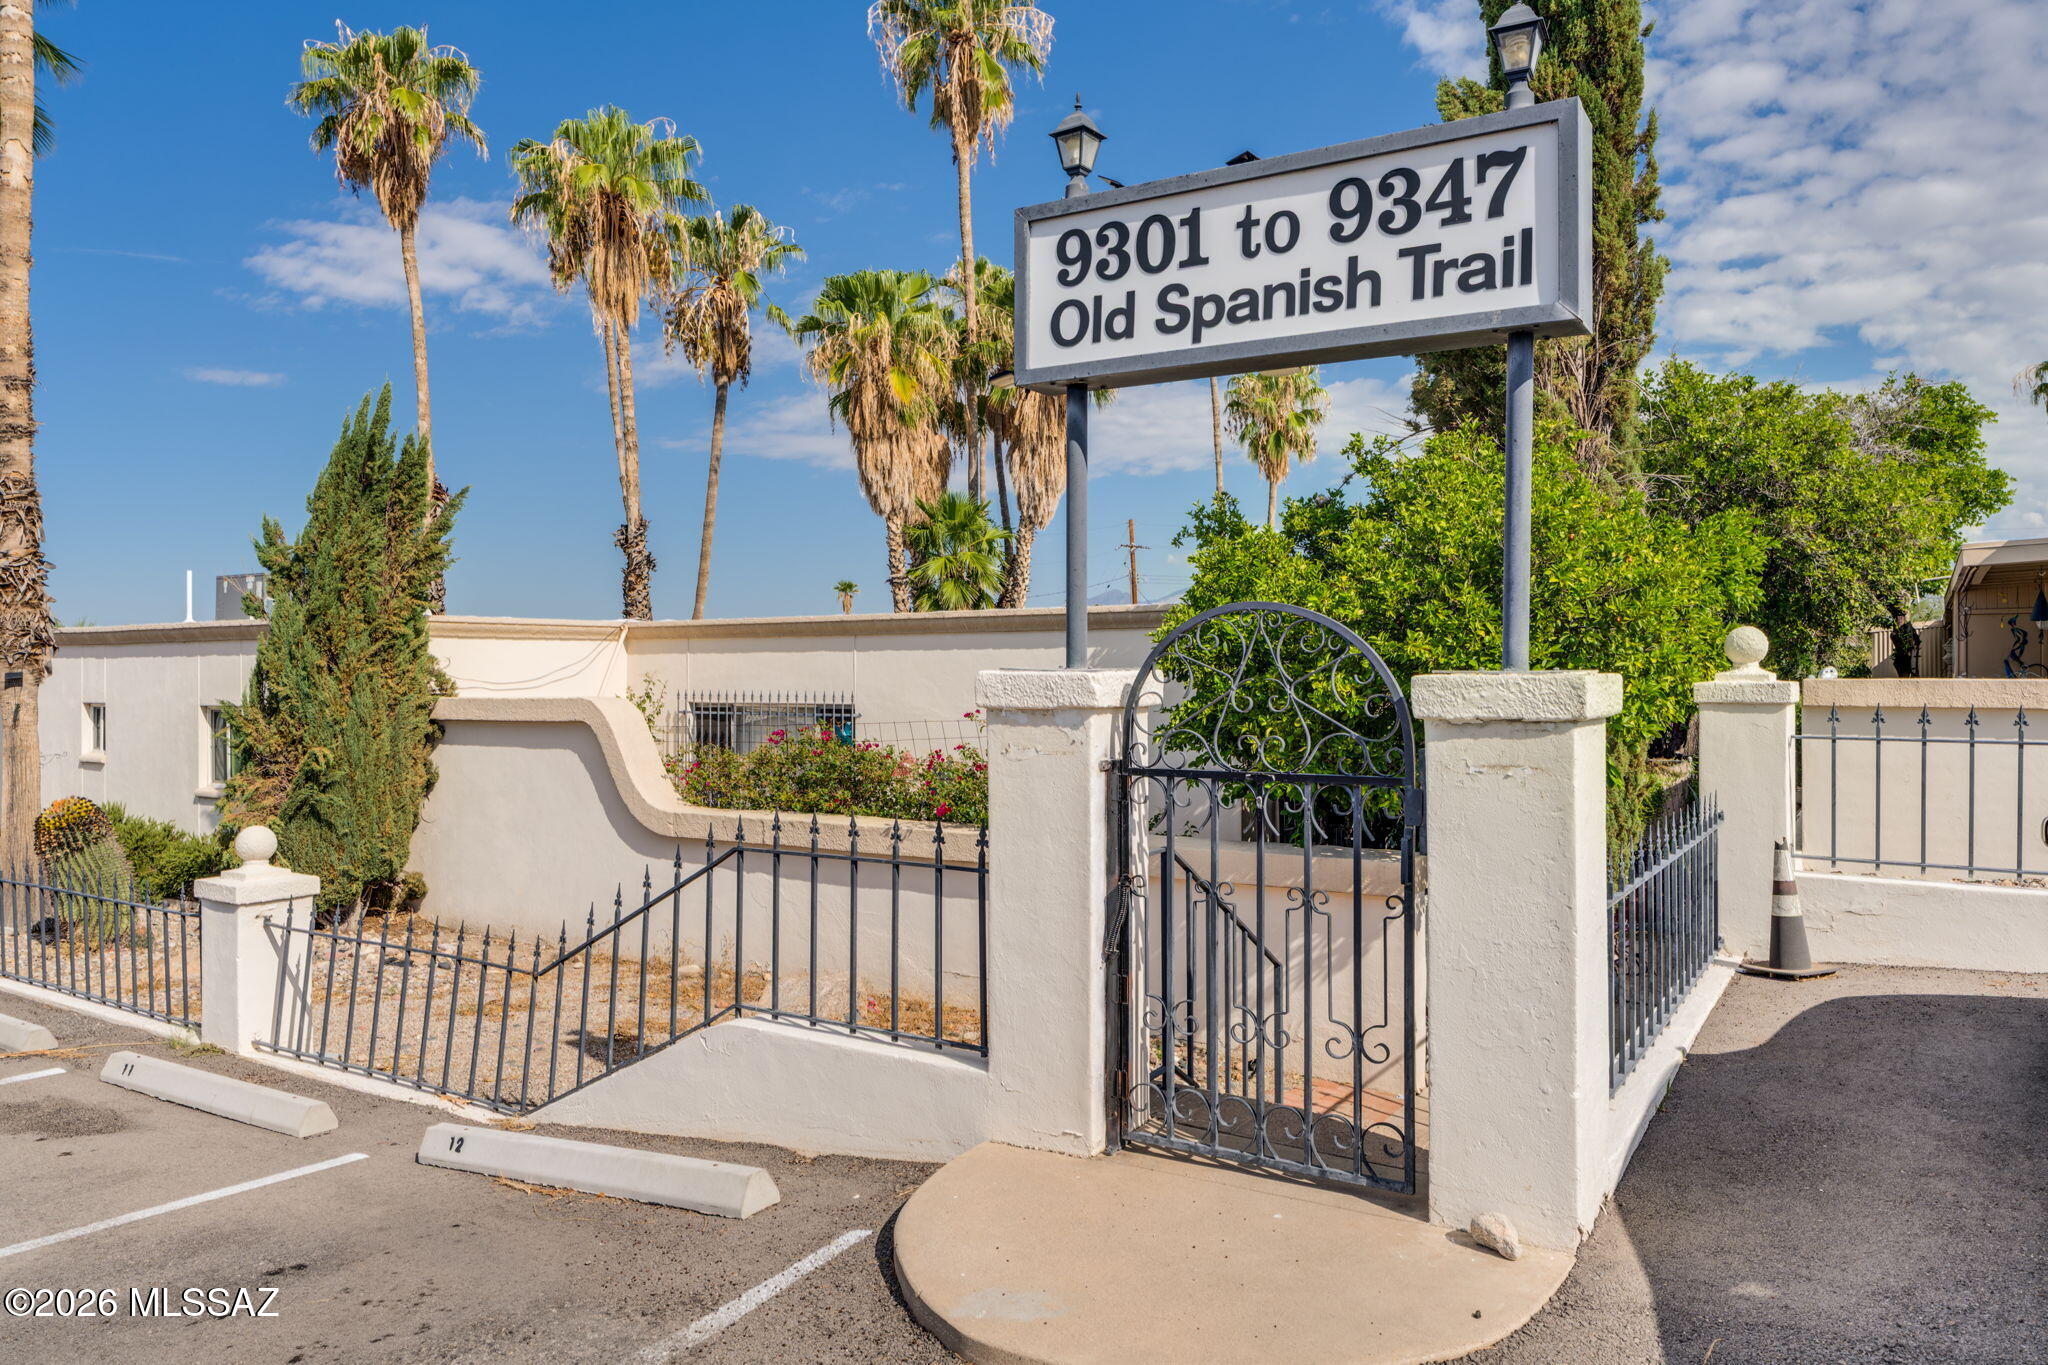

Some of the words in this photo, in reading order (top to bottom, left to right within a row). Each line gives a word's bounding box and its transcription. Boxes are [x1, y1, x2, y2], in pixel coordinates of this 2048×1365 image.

[1056, 206, 1210, 288] 9301
[1235, 204, 1301, 259] to
[1328, 145, 1529, 244] 9347
[1050, 290, 1136, 348] Old
[1155, 255, 1382, 345] Spanish
[1398, 227, 1534, 301] Trail
[449, 1136, 465, 1153] 12
